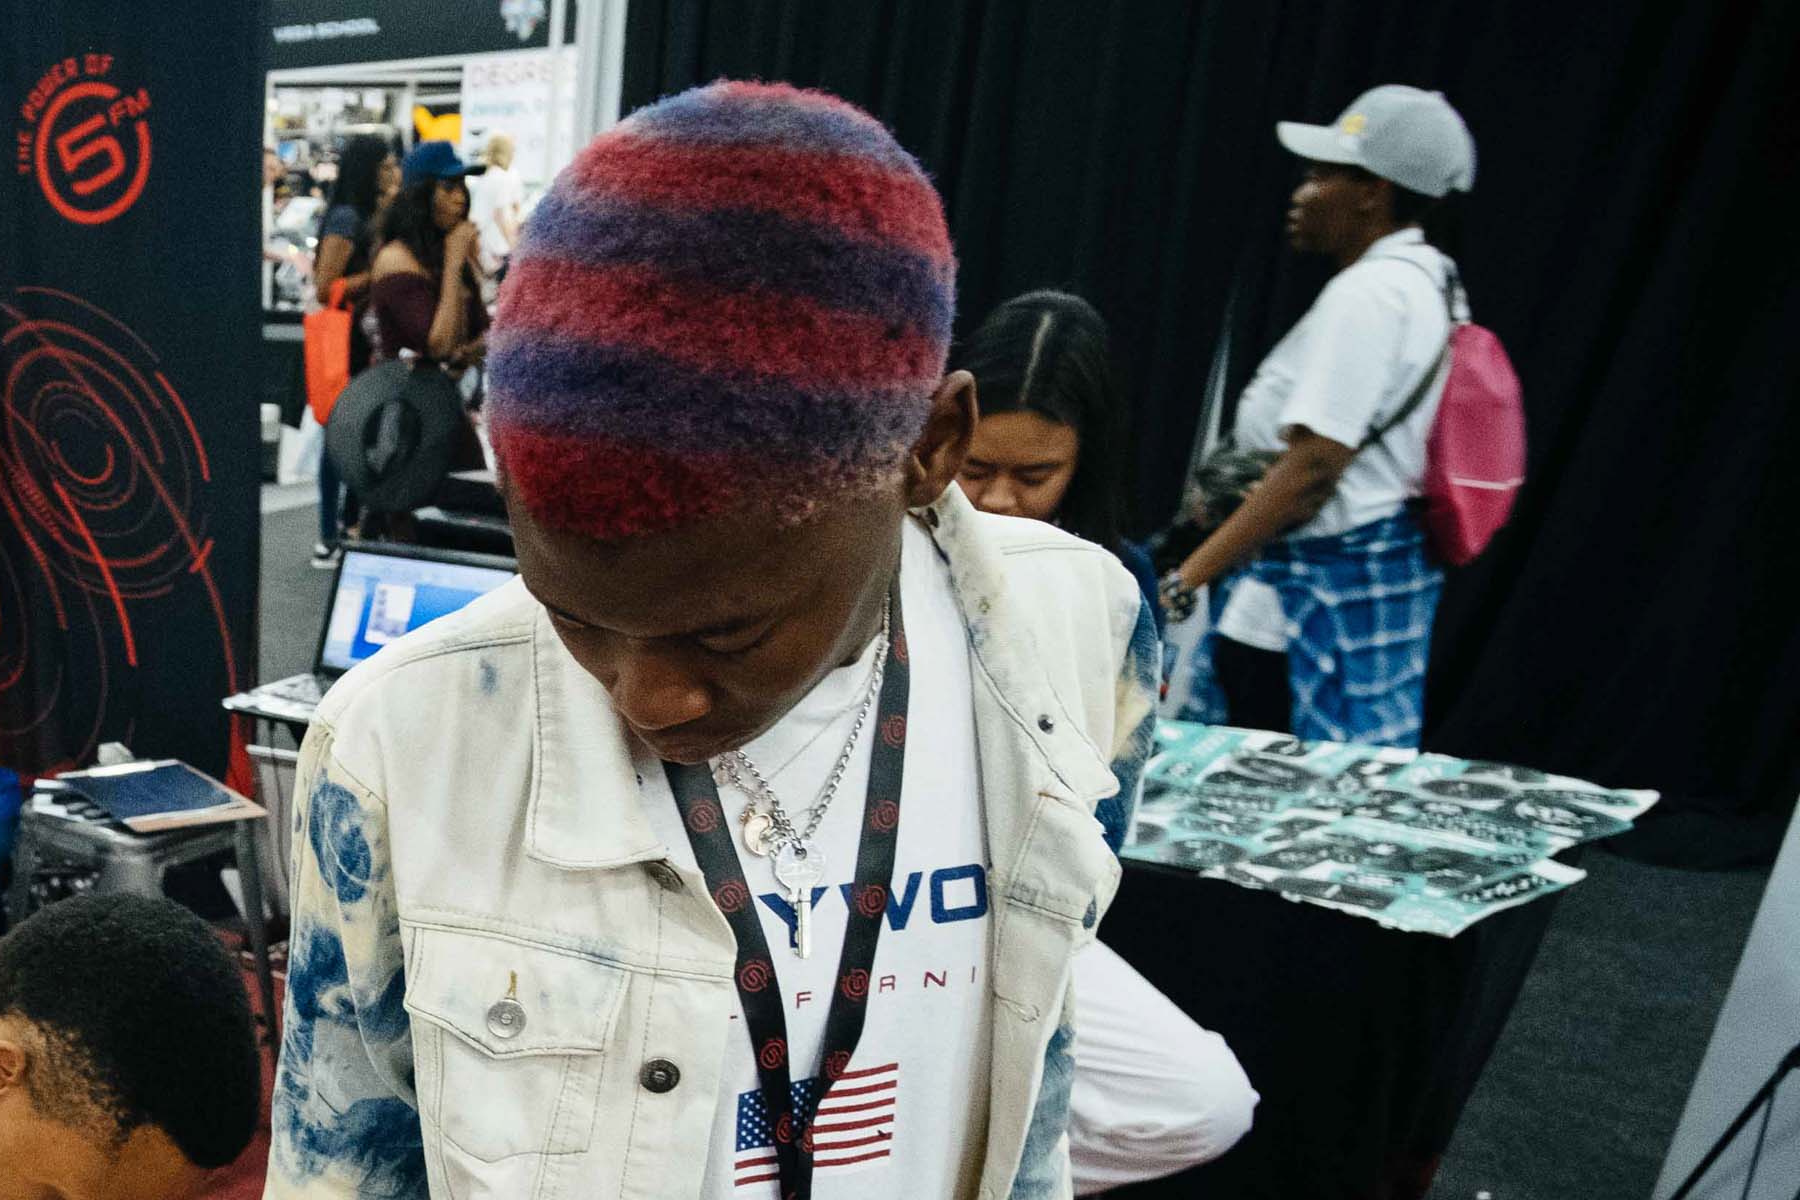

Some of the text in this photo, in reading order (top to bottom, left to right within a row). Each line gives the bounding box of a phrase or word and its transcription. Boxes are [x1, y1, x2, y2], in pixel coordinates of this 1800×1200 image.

[21, 57, 79, 123] POWER
[84, 53, 114, 76] OF
[108, 87, 151, 126] FM
